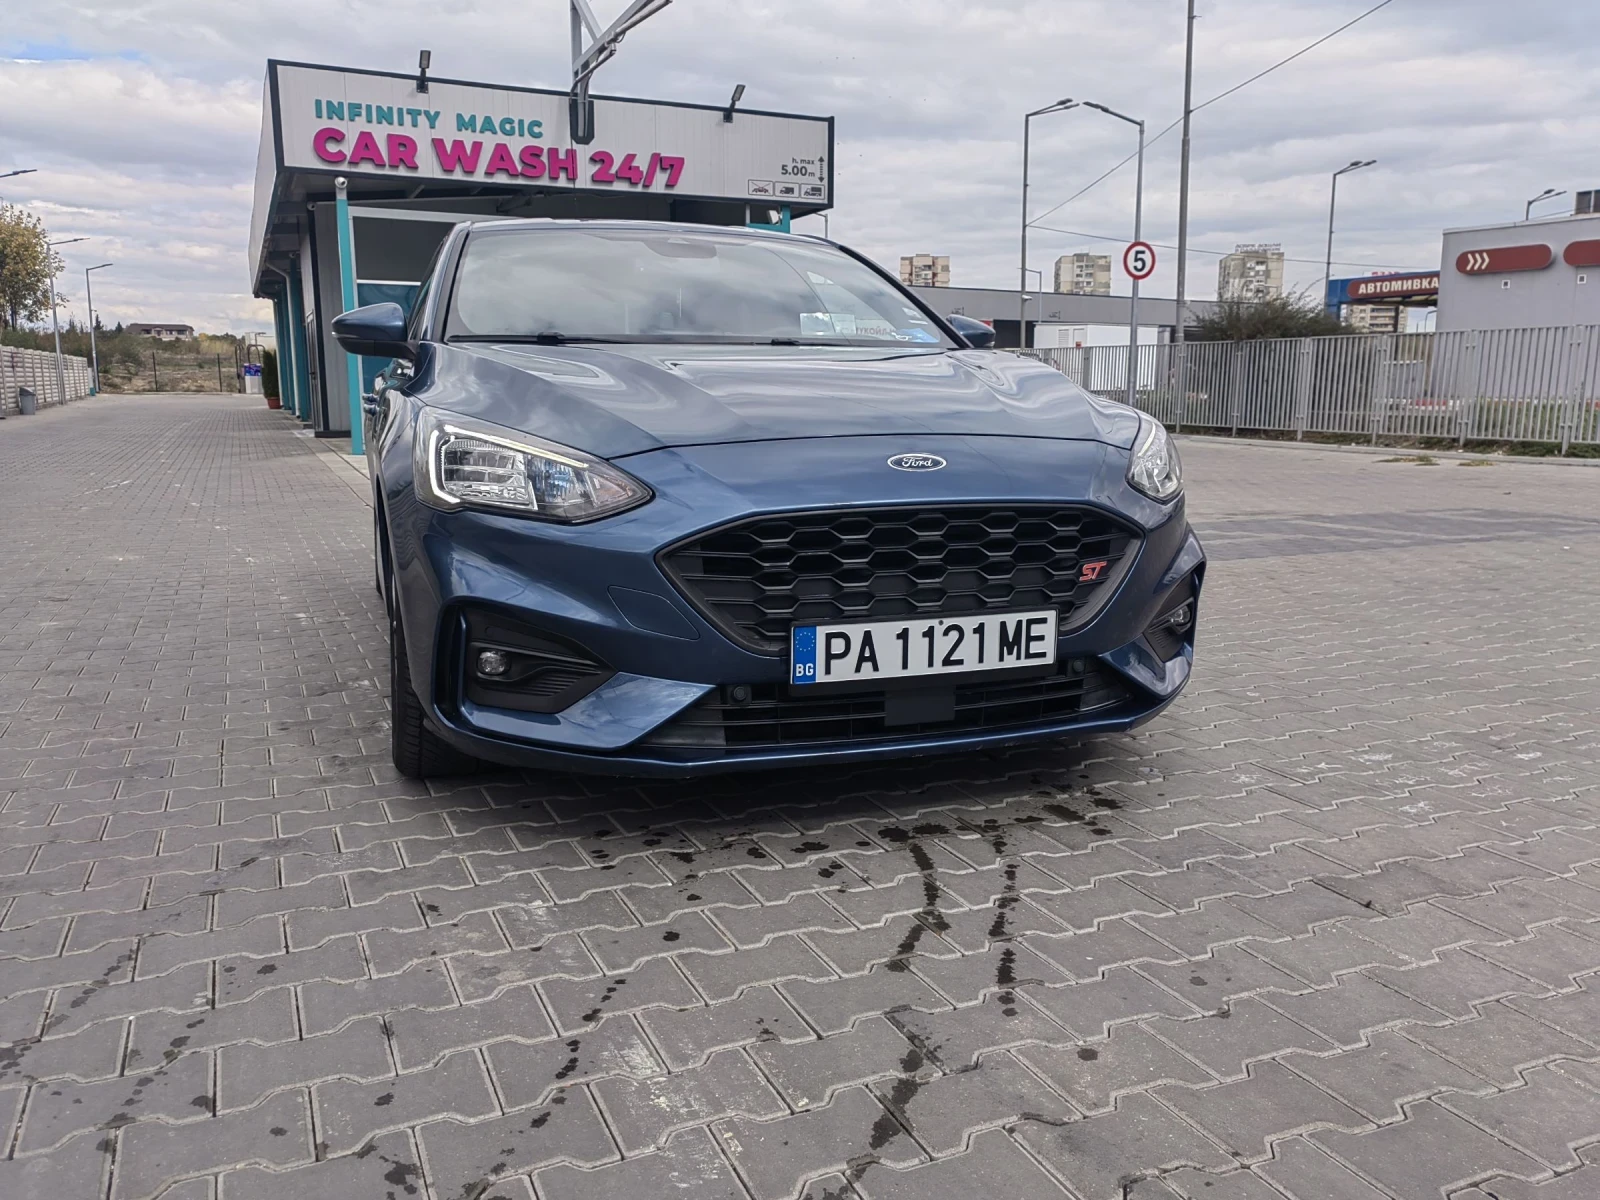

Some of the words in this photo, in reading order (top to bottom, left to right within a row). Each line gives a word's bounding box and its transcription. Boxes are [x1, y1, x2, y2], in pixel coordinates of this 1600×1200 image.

[315, 99, 441, 129] INFINITY
[456, 113, 544, 139] MAGIC
[313, 127, 419, 169] CAR
[432, 138, 578, 180] WASH
[590, 150, 685, 188] 24/7
[1133, 250, 1146, 272] 5
[1358, 277, 1439, 295] АВТОМИВКА
[902, 456, 933, 467] Ford
[1079, 560, 1108, 581] ST
[824, 630, 879, 676] PA
[896, 622, 985, 671] 1121
[998, 617, 1048, 663] ME
[795, 663, 814, 677] BG
